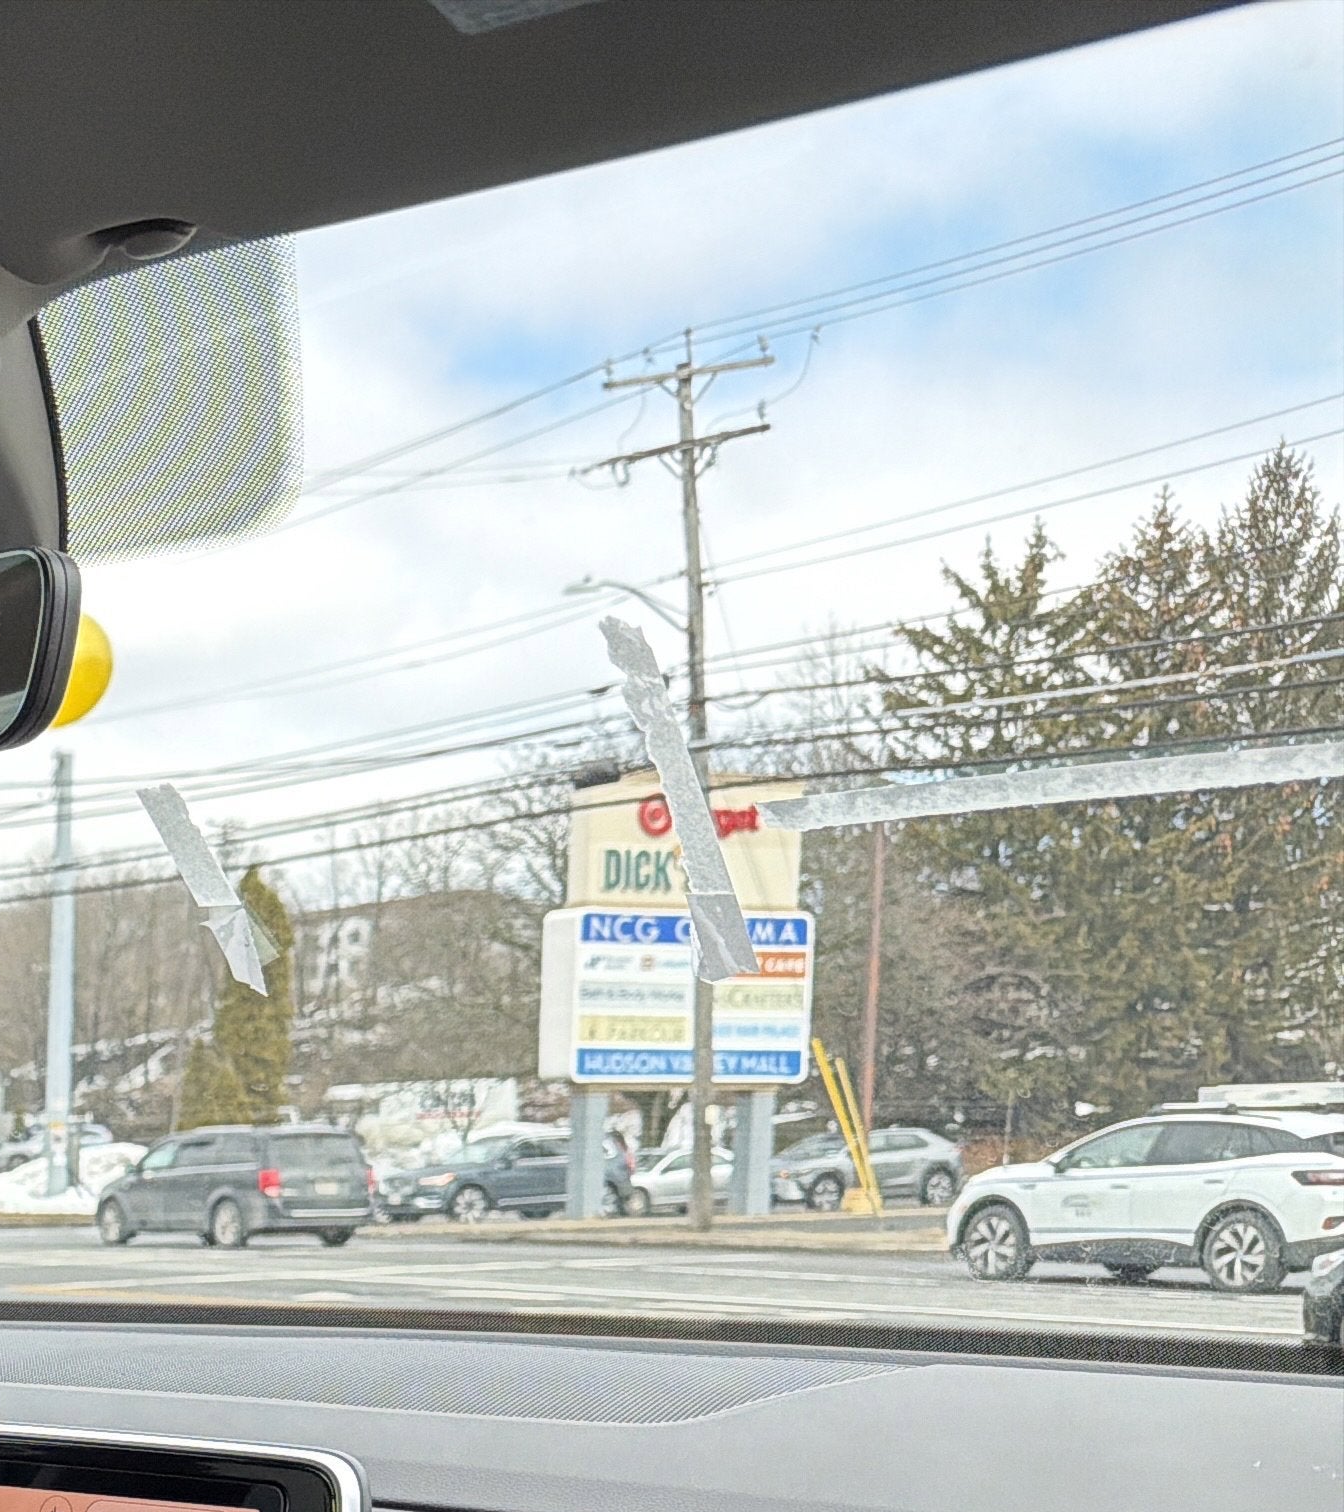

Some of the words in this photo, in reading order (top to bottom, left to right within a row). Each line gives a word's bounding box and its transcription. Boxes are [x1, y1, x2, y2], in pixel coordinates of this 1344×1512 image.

[589, 917, 661, 942] NCG
[675, 919, 799, 945] CMA
[584, 1053, 666, 1073] HUDSON
[669, 1053, 740, 1073] VAEY
